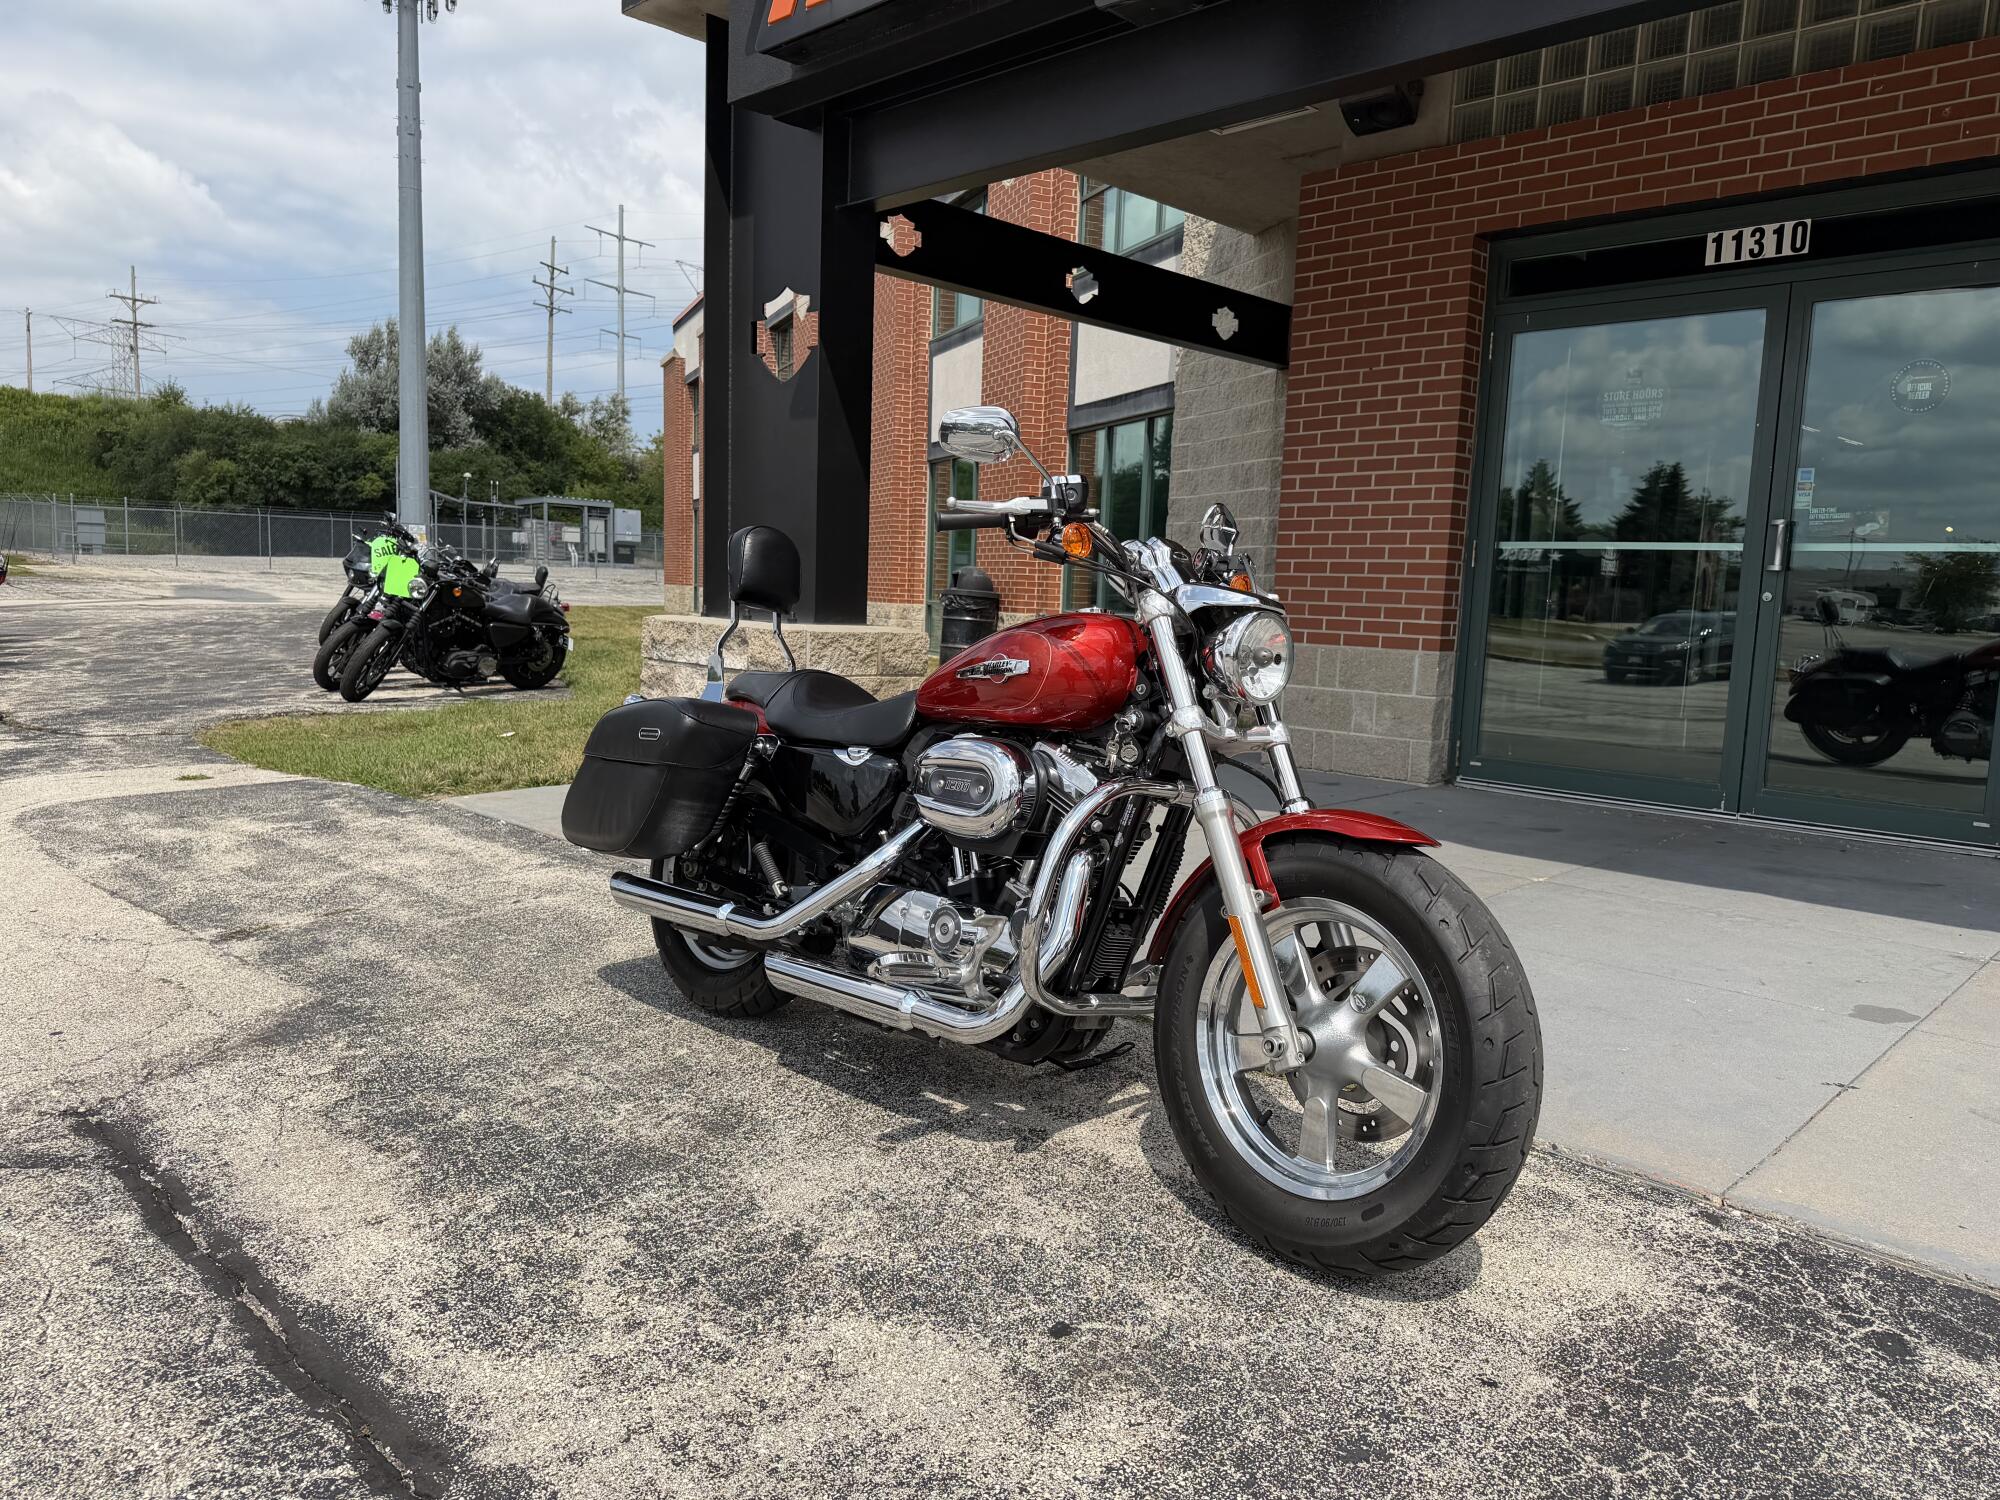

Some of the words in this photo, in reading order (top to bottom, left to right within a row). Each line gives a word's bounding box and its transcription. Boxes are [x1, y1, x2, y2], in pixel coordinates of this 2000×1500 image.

[1711, 220, 1808, 263] 11310
[1603, 391, 1631, 402] STORE
[1632, 388, 1664, 400] HOURS
[374, 544, 399, 558] SALE
[944, 780, 970, 793] 1200
